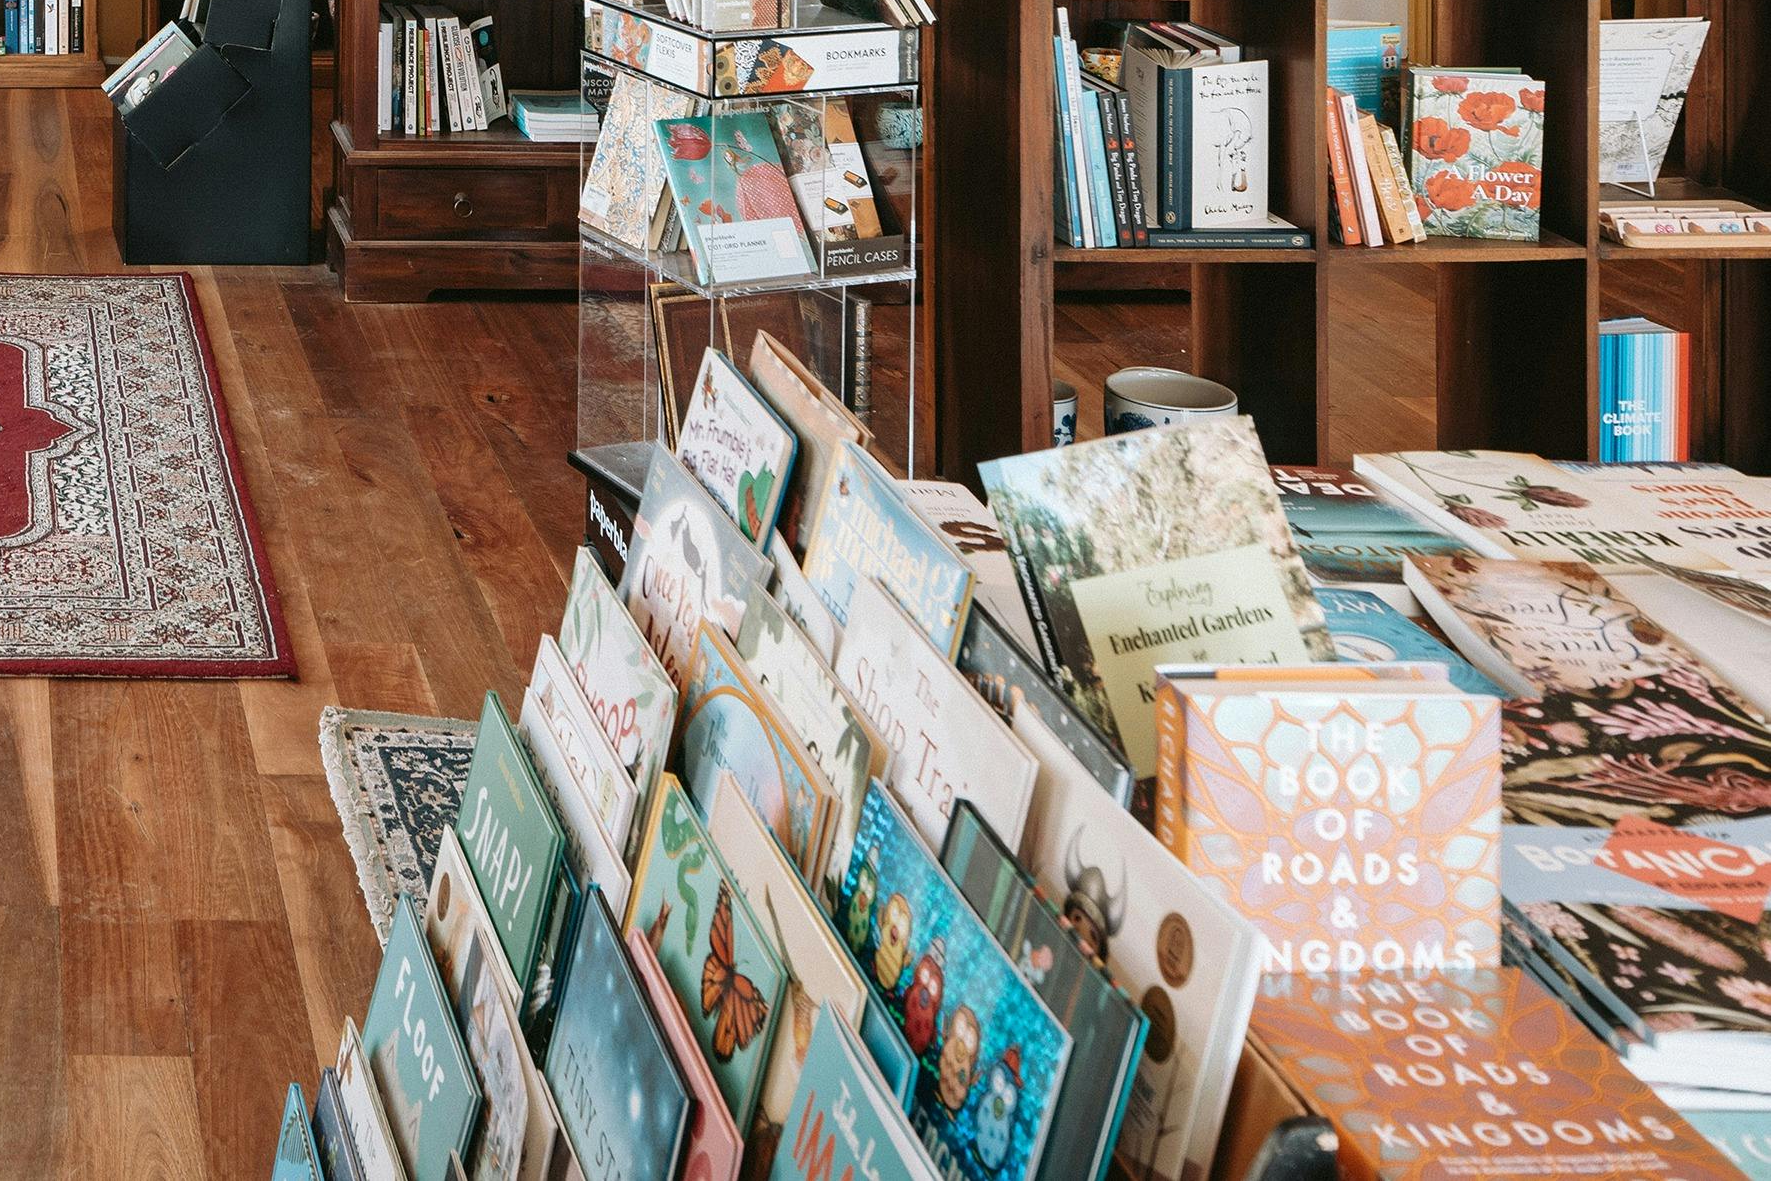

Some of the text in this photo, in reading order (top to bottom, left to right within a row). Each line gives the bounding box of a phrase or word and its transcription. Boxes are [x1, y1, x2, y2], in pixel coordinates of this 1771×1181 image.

[655, 43, 676, 59] FLEXIS
[656, 33, 692, 53] SOFTCOVER
[826, 47, 887, 61] BOOKMARKS
[407, 27, 415, 95] RESILIENCE PROJECT
[1447, 165, 1534, 185] A Flower
[1470, 187, 1534, 206] A Day
[827, 250, 899, 267] PENCIL CASES
[1619, 400, 1646, 412] THE
[1603, 413, 1661, 426] CLIMATE
[1613, 425, 1652, 437] BOOK
[1500, 530, 1683, 548] KENEALLY
[1108, 602, 1275, 657] Enchanted Gardens
[1304, 720, 1385, 755] THE
[1279, 763, 1412, 799] BOOK
[1315, 807, 1376, 842] OF
[464, 786, 532, 932] SNAP!
[1262, 850, 1421, 886] ROADS
[1332, 896, 1360, 929] &
[1342, 979, 1435, 1005] THE
[394, 956, 446, 1102] FLOOF
[1338, 1007, 1490, 1033] BOOK
[1404, 1034, 1471, 1058] OF
[1372, 1061, 1553, 1088] ROADS
[1475, 1092, 1518, 1117] &
[1370, 1116, 1676, 1150] KINGDOMS
